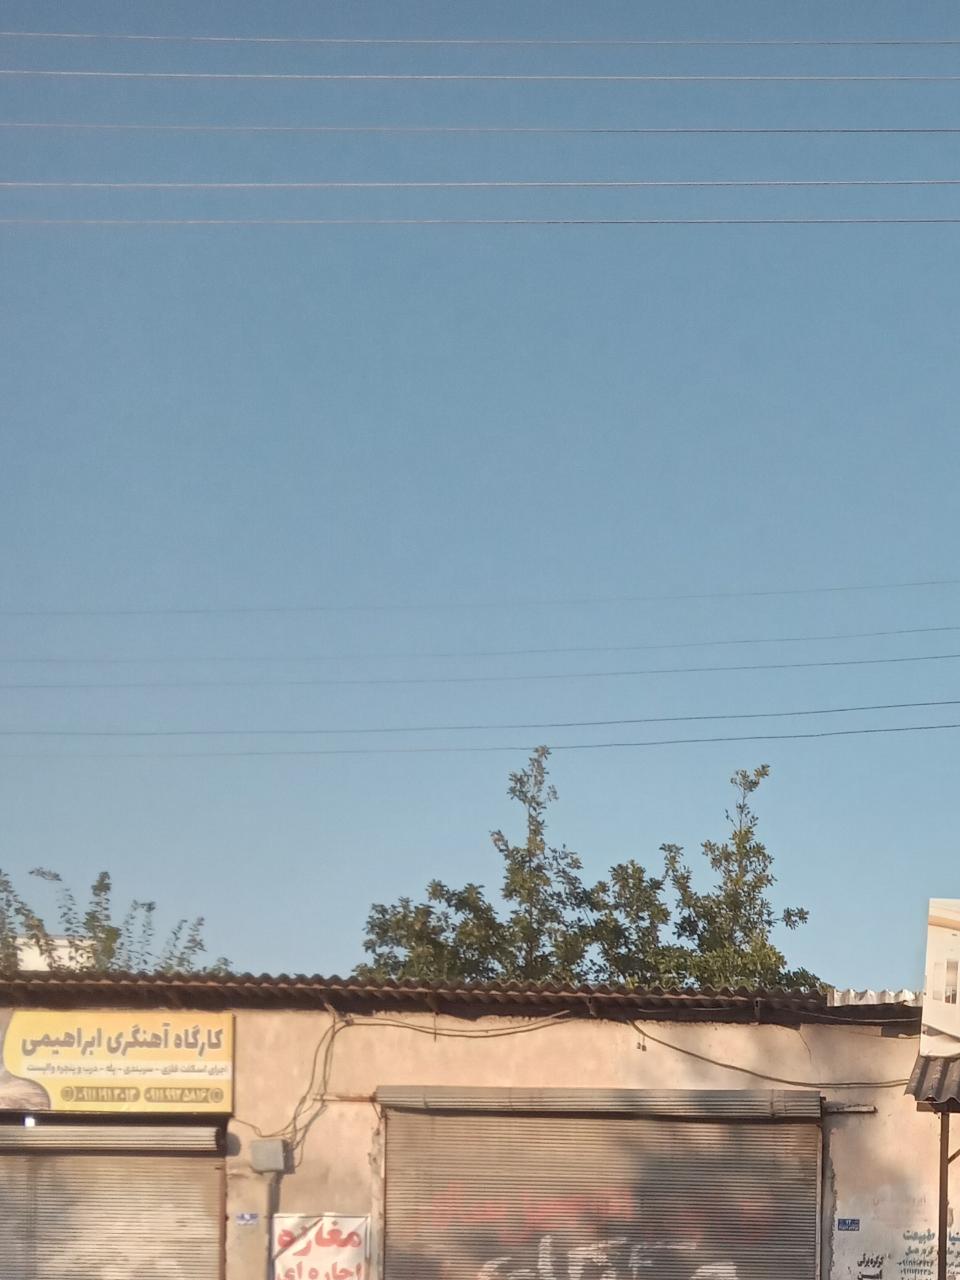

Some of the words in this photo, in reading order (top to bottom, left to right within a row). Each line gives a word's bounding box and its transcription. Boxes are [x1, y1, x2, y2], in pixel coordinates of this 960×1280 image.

[21, 1027, 102, 1056] ابراهیمی
[107, 1022, 171, 1056] آهنگری
[174, 1024, 223, 1057] کارگاه
[277, 1220, 362, 1257] مغازه
